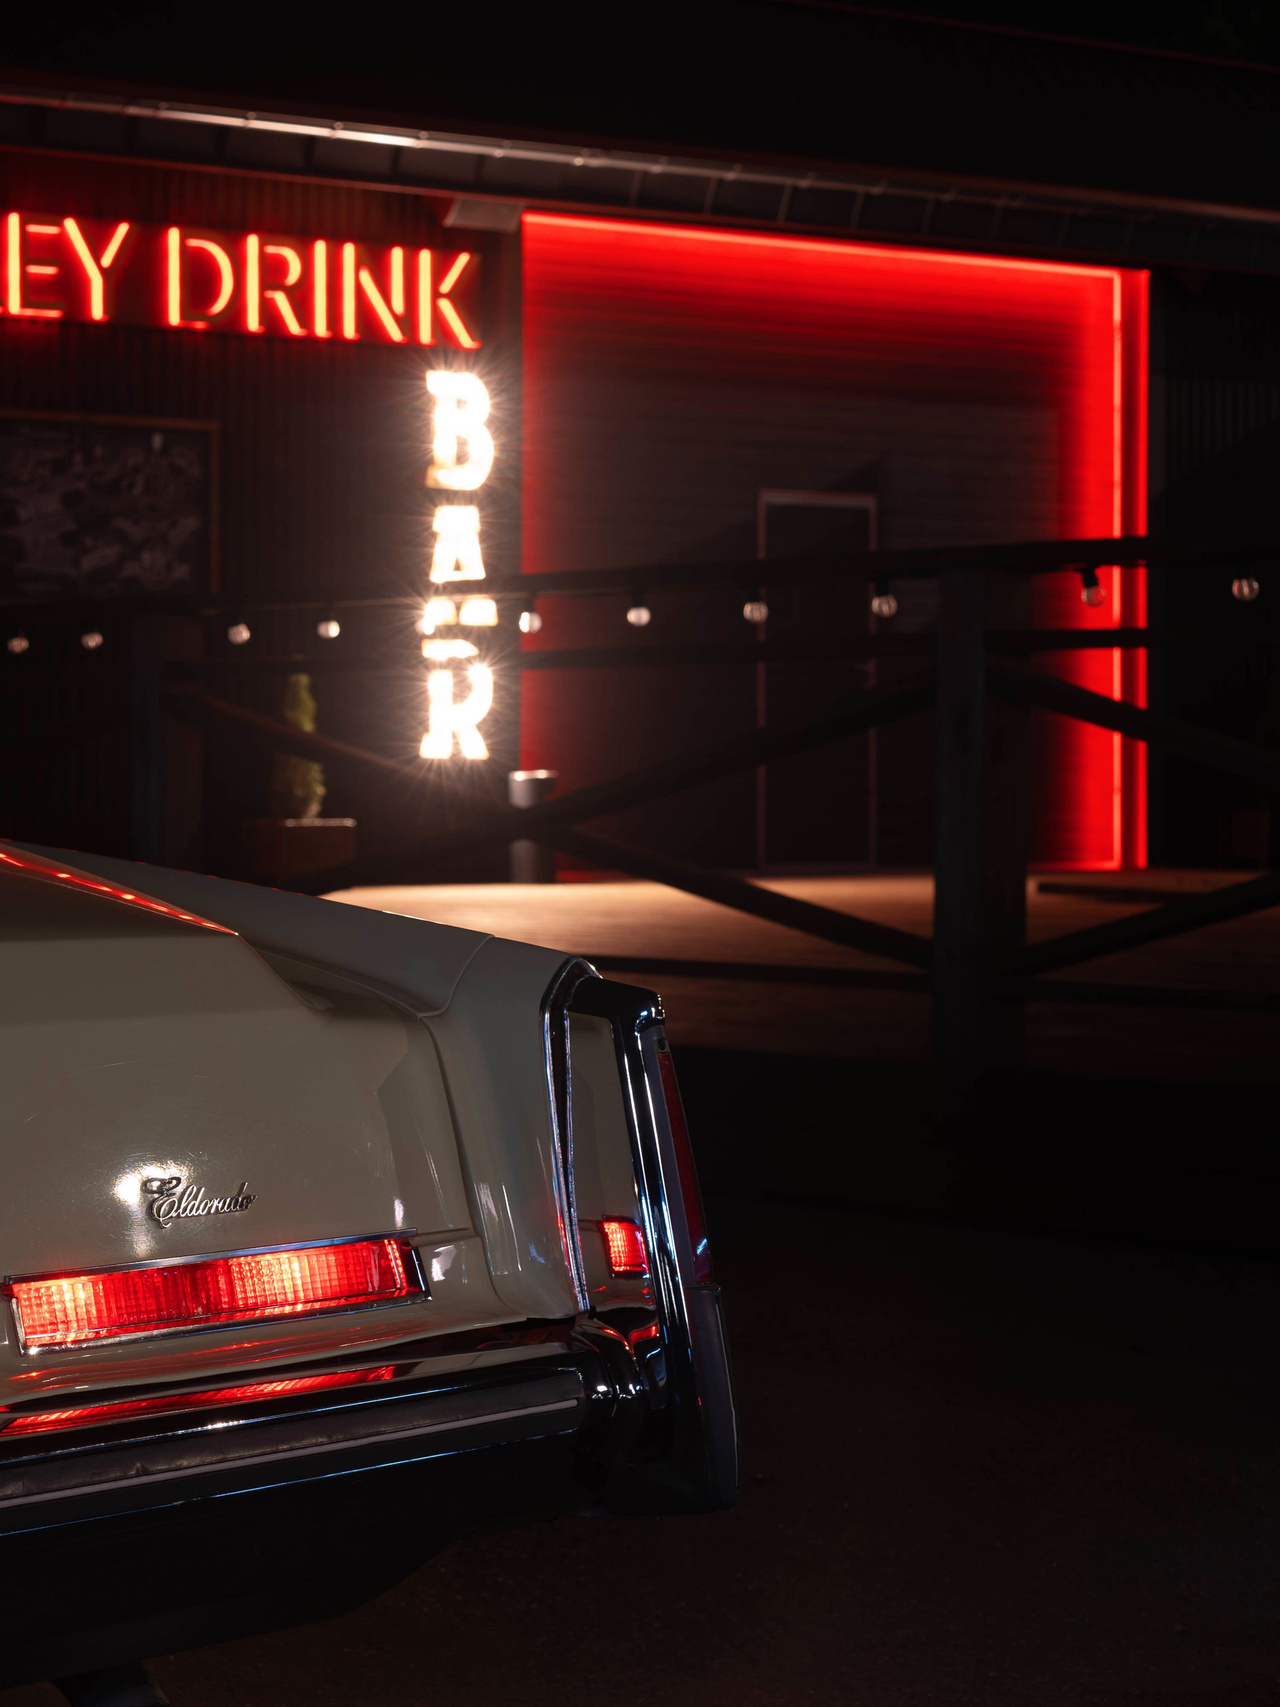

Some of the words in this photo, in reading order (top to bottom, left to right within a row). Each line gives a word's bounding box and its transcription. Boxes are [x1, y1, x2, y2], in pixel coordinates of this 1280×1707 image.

[168, 227, 481, 349] DRINK
[419, 370, 495, 760] BAR
[143, 1176, 257, 1228] Eldorado
